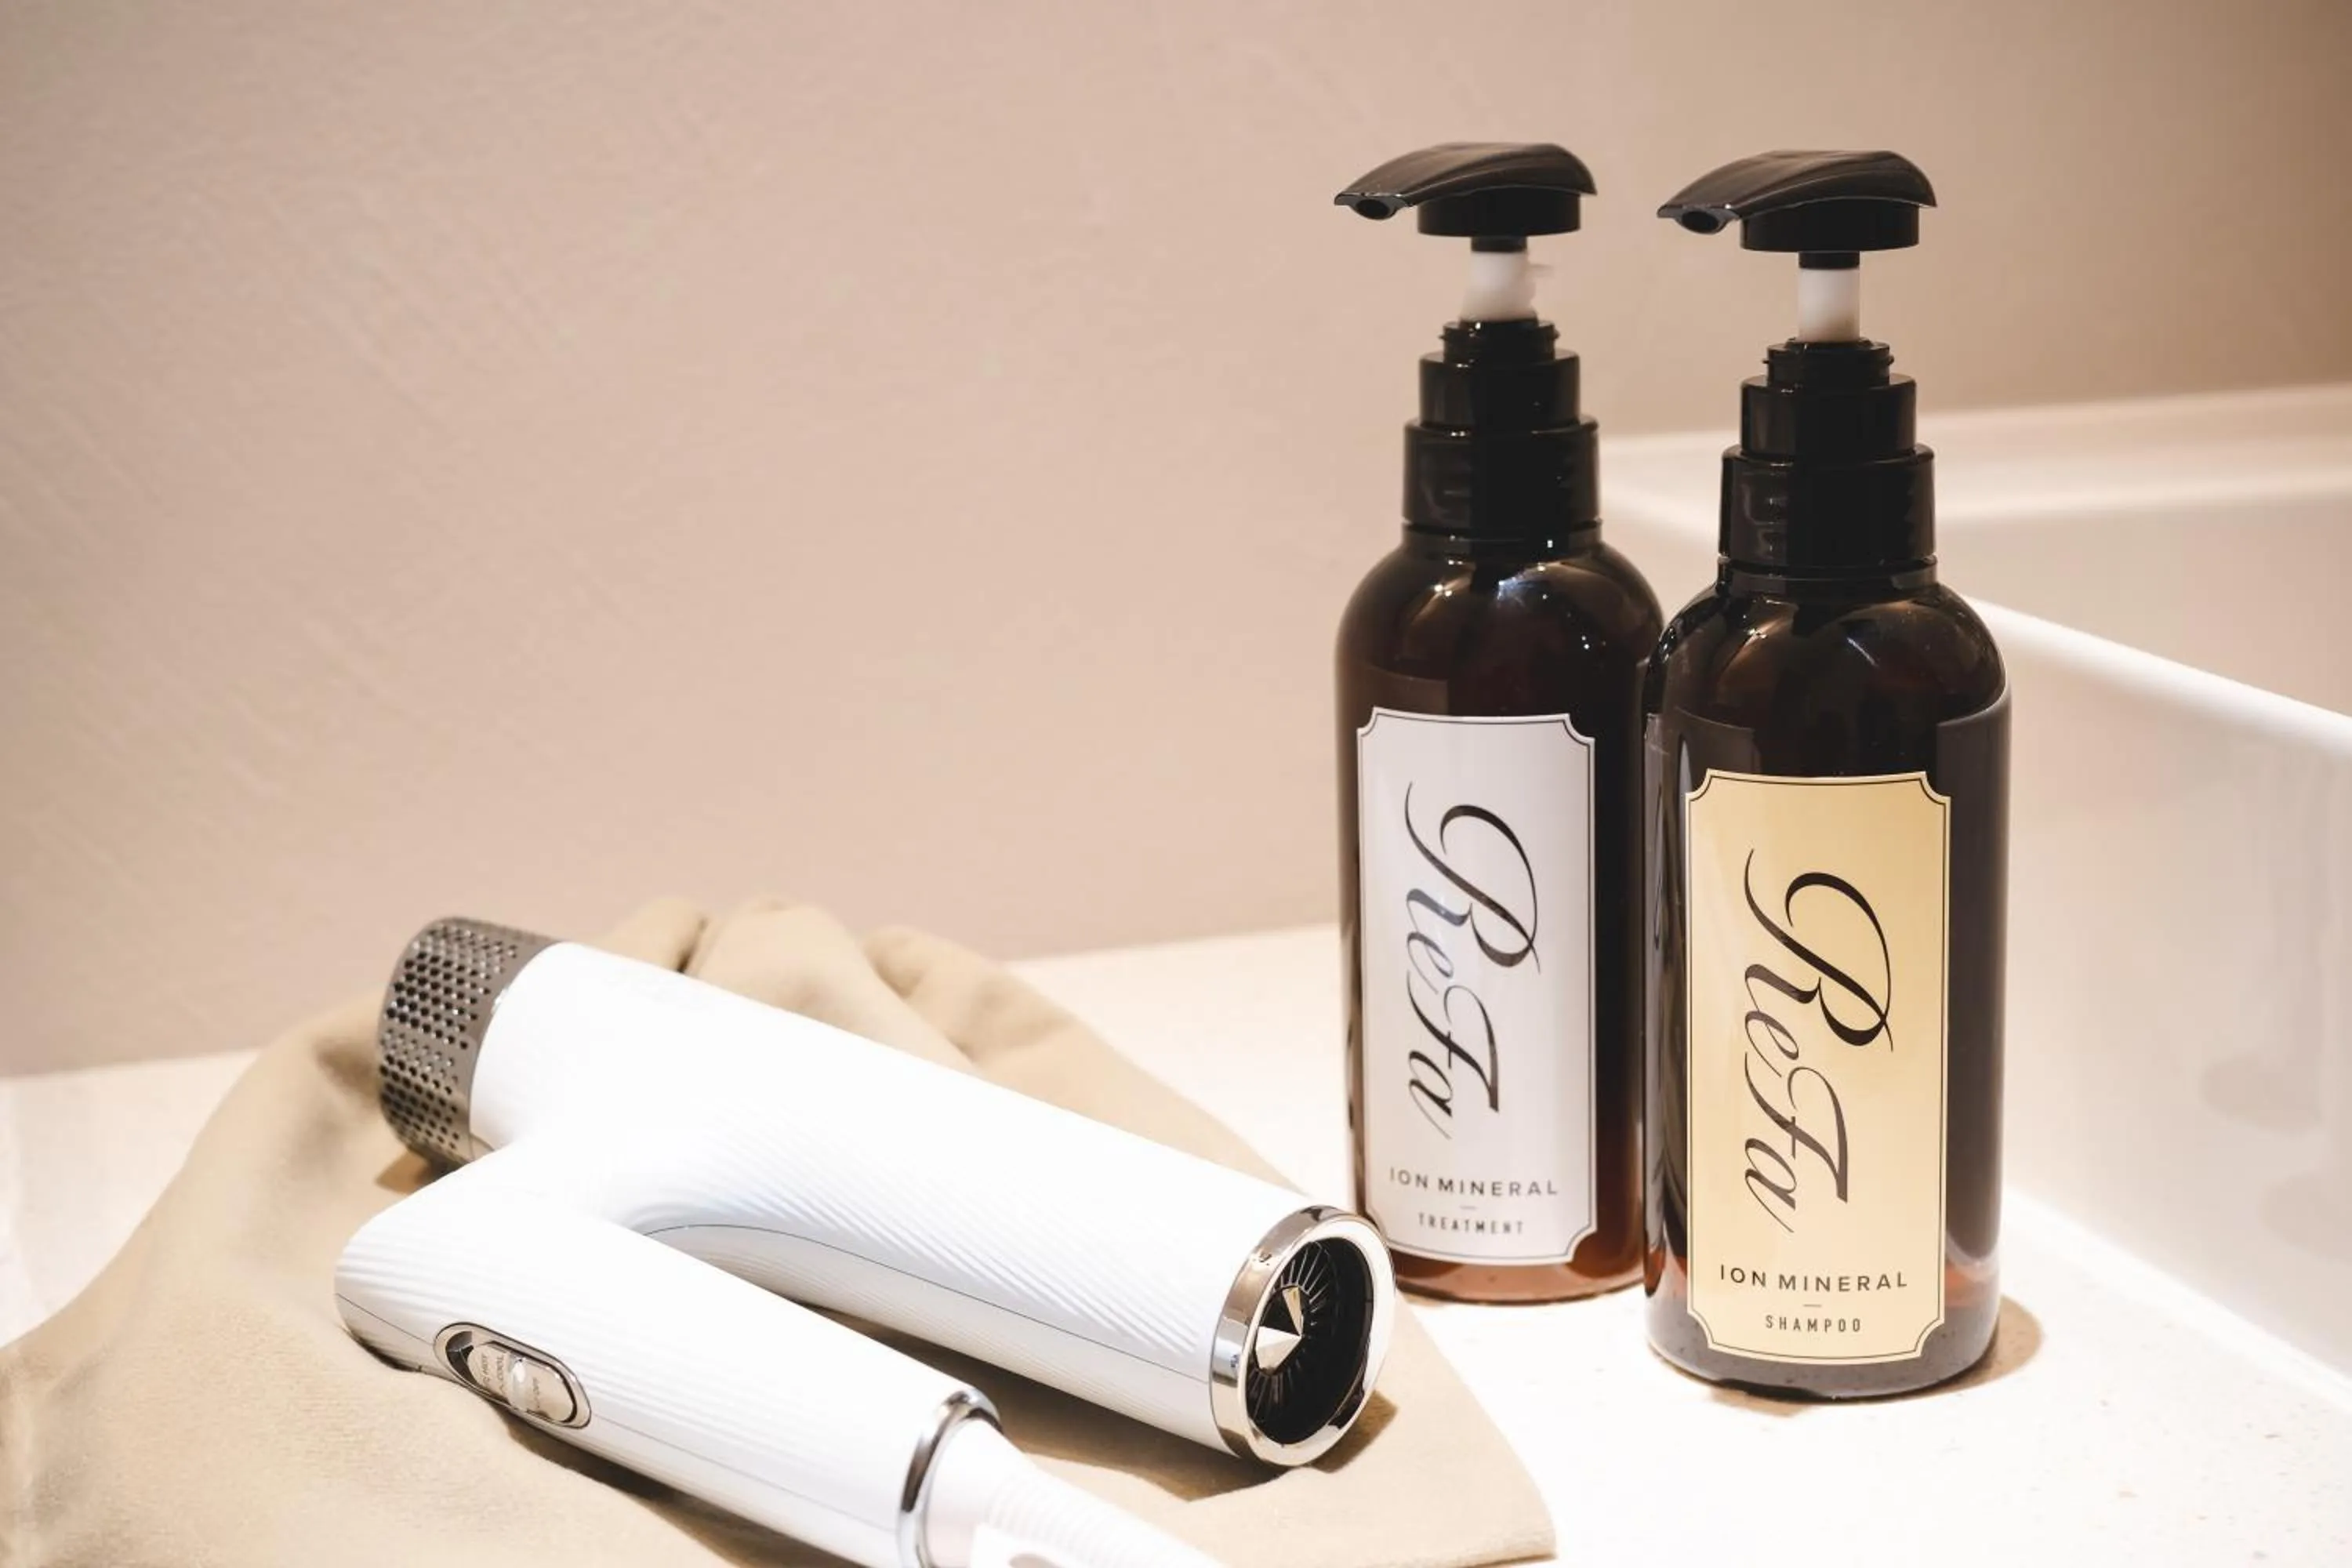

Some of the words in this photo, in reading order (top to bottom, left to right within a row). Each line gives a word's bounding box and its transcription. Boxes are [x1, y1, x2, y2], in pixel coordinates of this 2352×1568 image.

[1405, 780, 1541, 1140] ReFa
[1744, 848, 1893, 1233] ReFa
[1389, 1166, 1428, 1189] ION
[1437, 1178, 1559, 1196] MINERAL
[1417, 1212, 1524, 1235] TREATMENT
[1720, 1264, 1767, 1287] ION
[1778, 1271, 1907, 1292] MINERAL
[1765, 1314, 1861, 1333] SHAMPOO
